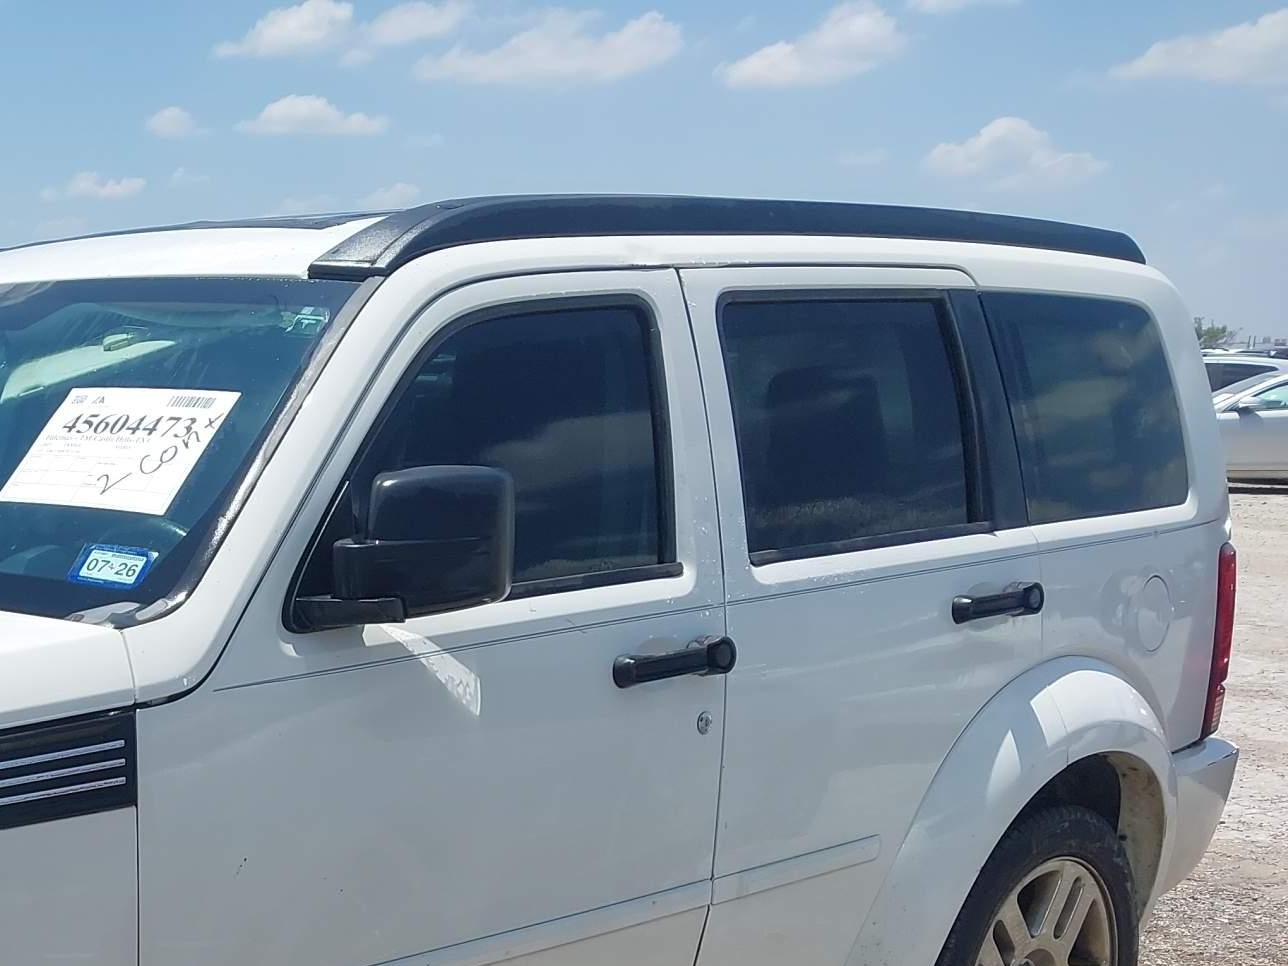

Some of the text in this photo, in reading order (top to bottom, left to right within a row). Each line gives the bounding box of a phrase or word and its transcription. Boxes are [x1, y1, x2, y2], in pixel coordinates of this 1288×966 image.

[62, 413, 198, 439] 45604473
[86, 558, 111, 573] 07
[114, 562, 139, 578] 26
